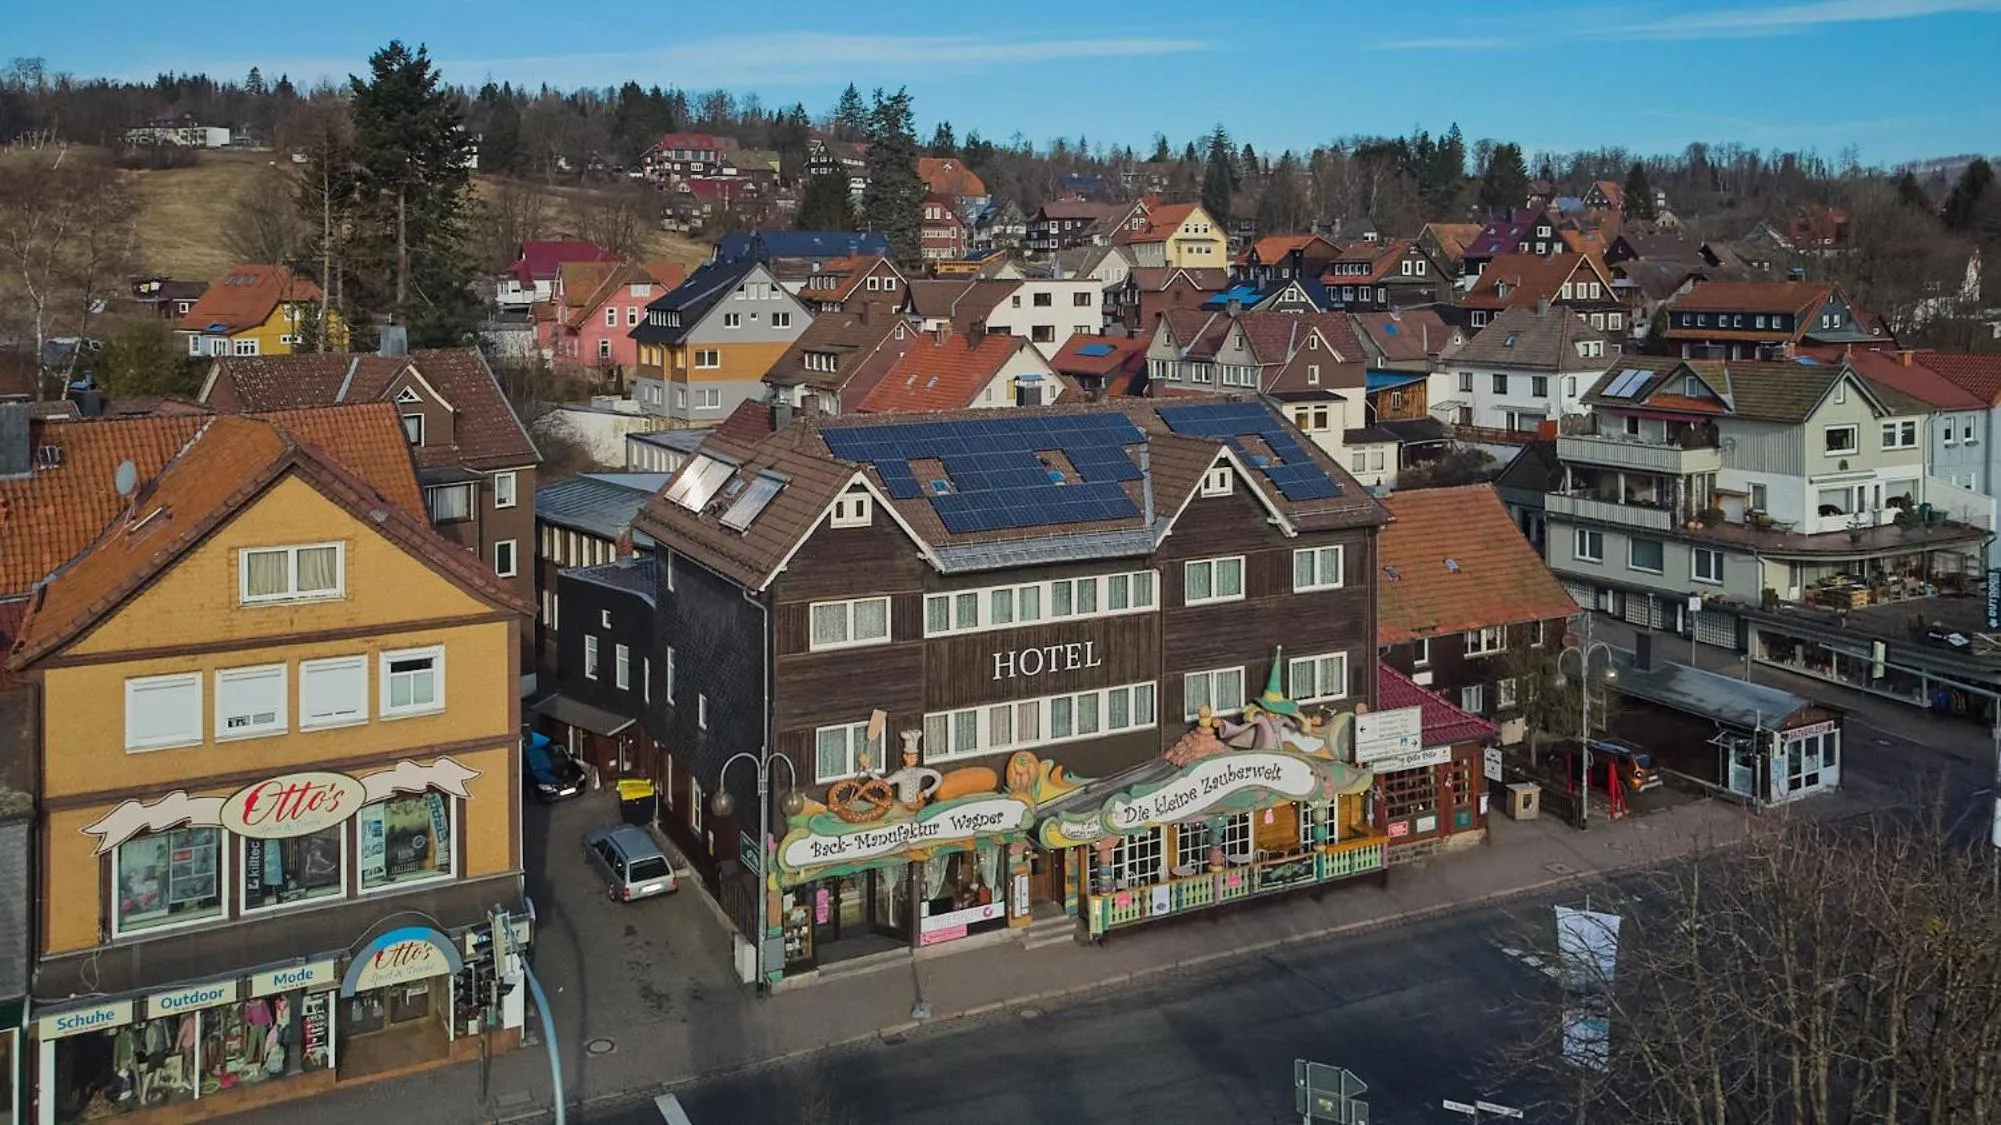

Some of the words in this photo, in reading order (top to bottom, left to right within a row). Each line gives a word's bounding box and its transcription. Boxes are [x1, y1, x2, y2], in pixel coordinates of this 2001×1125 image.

[992, 641, 1101, 680] HOTEL
[242, 780, 344, 826] Otto's
[1124, 804, 1149, 824] Die
[1155, 787, 1197, 817] kleine
[1201, 763, 1282, 795] Zauberwelt
[950, 812, 1004, 832] Wagner
[248, 841, 260, 878] killtec
[374, 941, 433, 969] Otto's
[274, 969, 313, 986] Mode
[161, 987, 225, 1010] Outdoor
[57, 1009, 115, 1031] Schuhe
